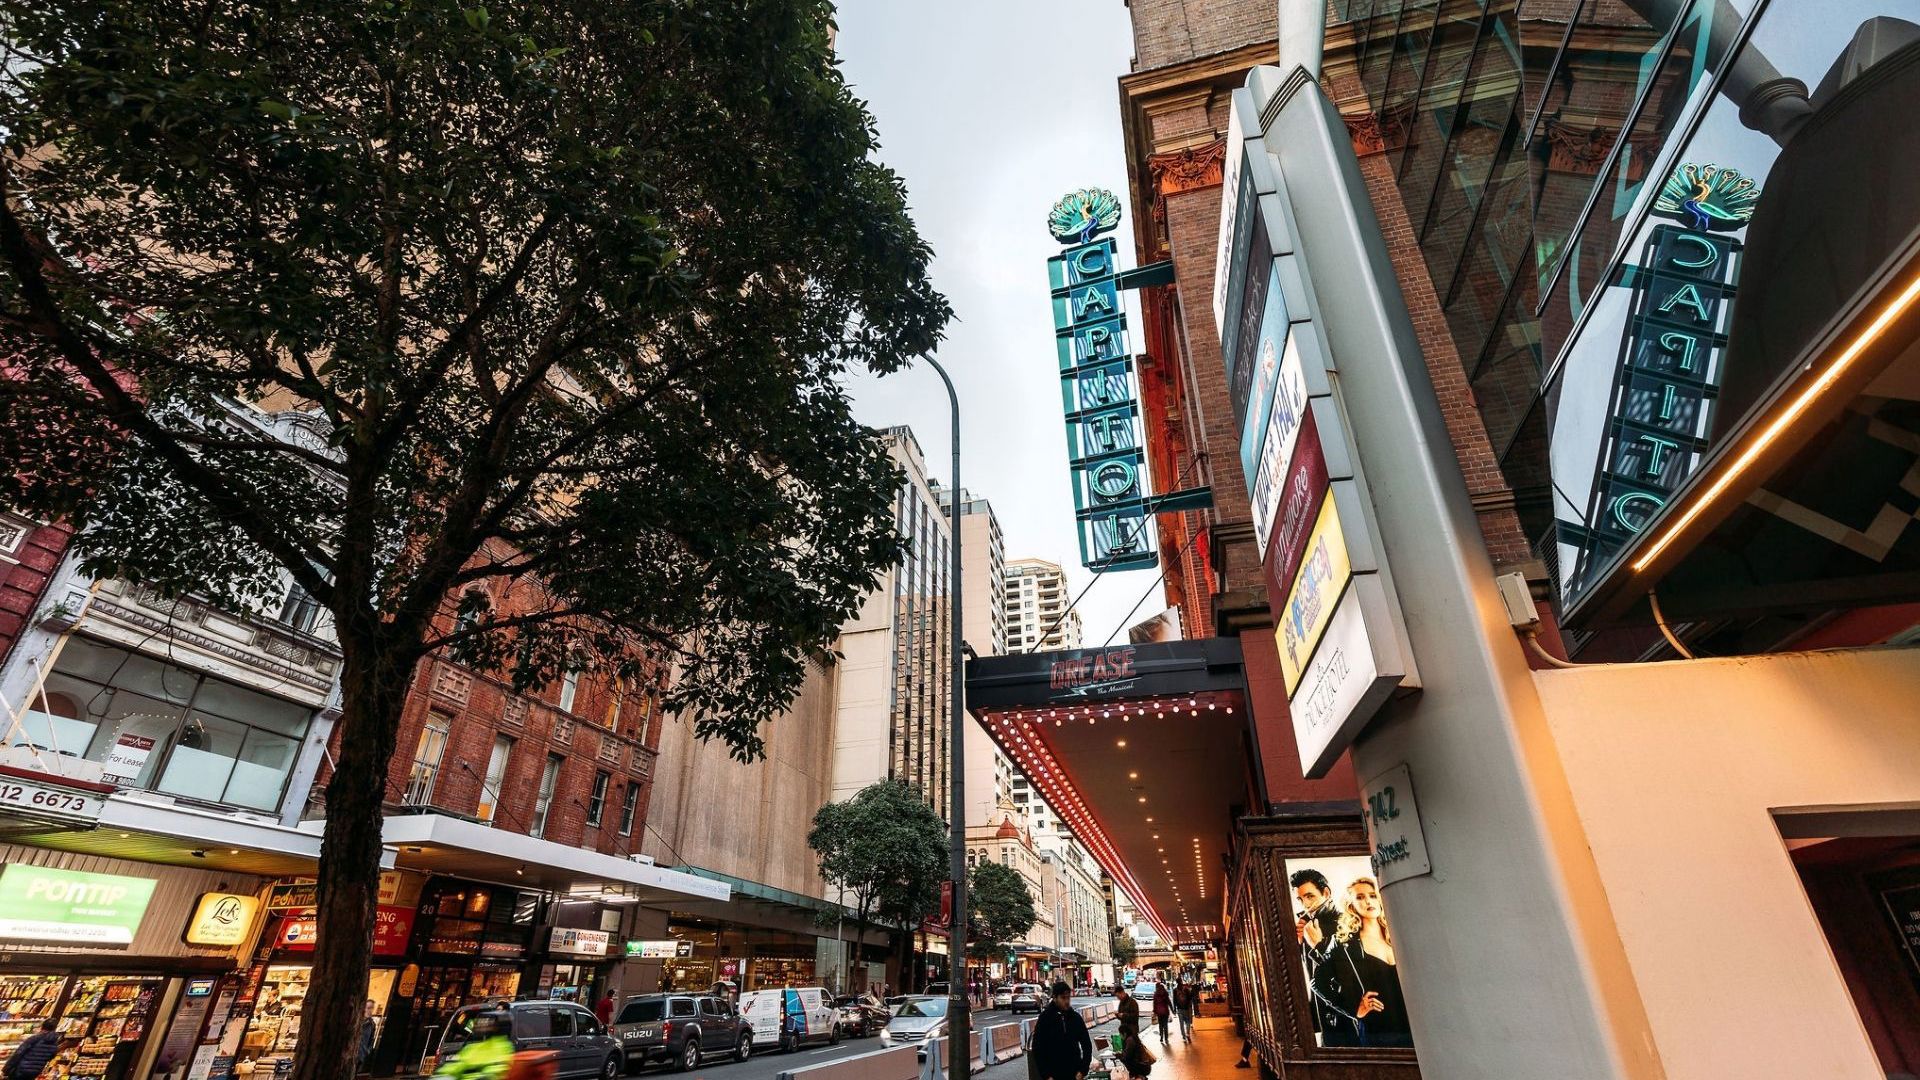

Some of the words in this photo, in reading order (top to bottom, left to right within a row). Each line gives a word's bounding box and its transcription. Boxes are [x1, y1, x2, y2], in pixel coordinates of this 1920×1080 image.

[1238, 175, 1251, 262] COFFEE
[1075, 246, 1137, 554] CAPITOL
[1255, 449, 1274, 533] MUAY
[1272, 373, 1295, 449] THAI
[1050, 649, 1137, 690] GREASE
[109, 753, 122, 764] For
[123, 755, 144, 768] Lease
[32, 791, 85, 812] 6673
[1377, 834, 1410, 868] Street
[211, 899, 241, 922] Lek
[271, 894, 315, 906] PONTIP
[421, 904, 435, 915] 20
[577, 931, 607, 943] CONVENIENCE
[583, 943, 598, 953] STORE
[624, 1030, 653, 1040] ISUZU
